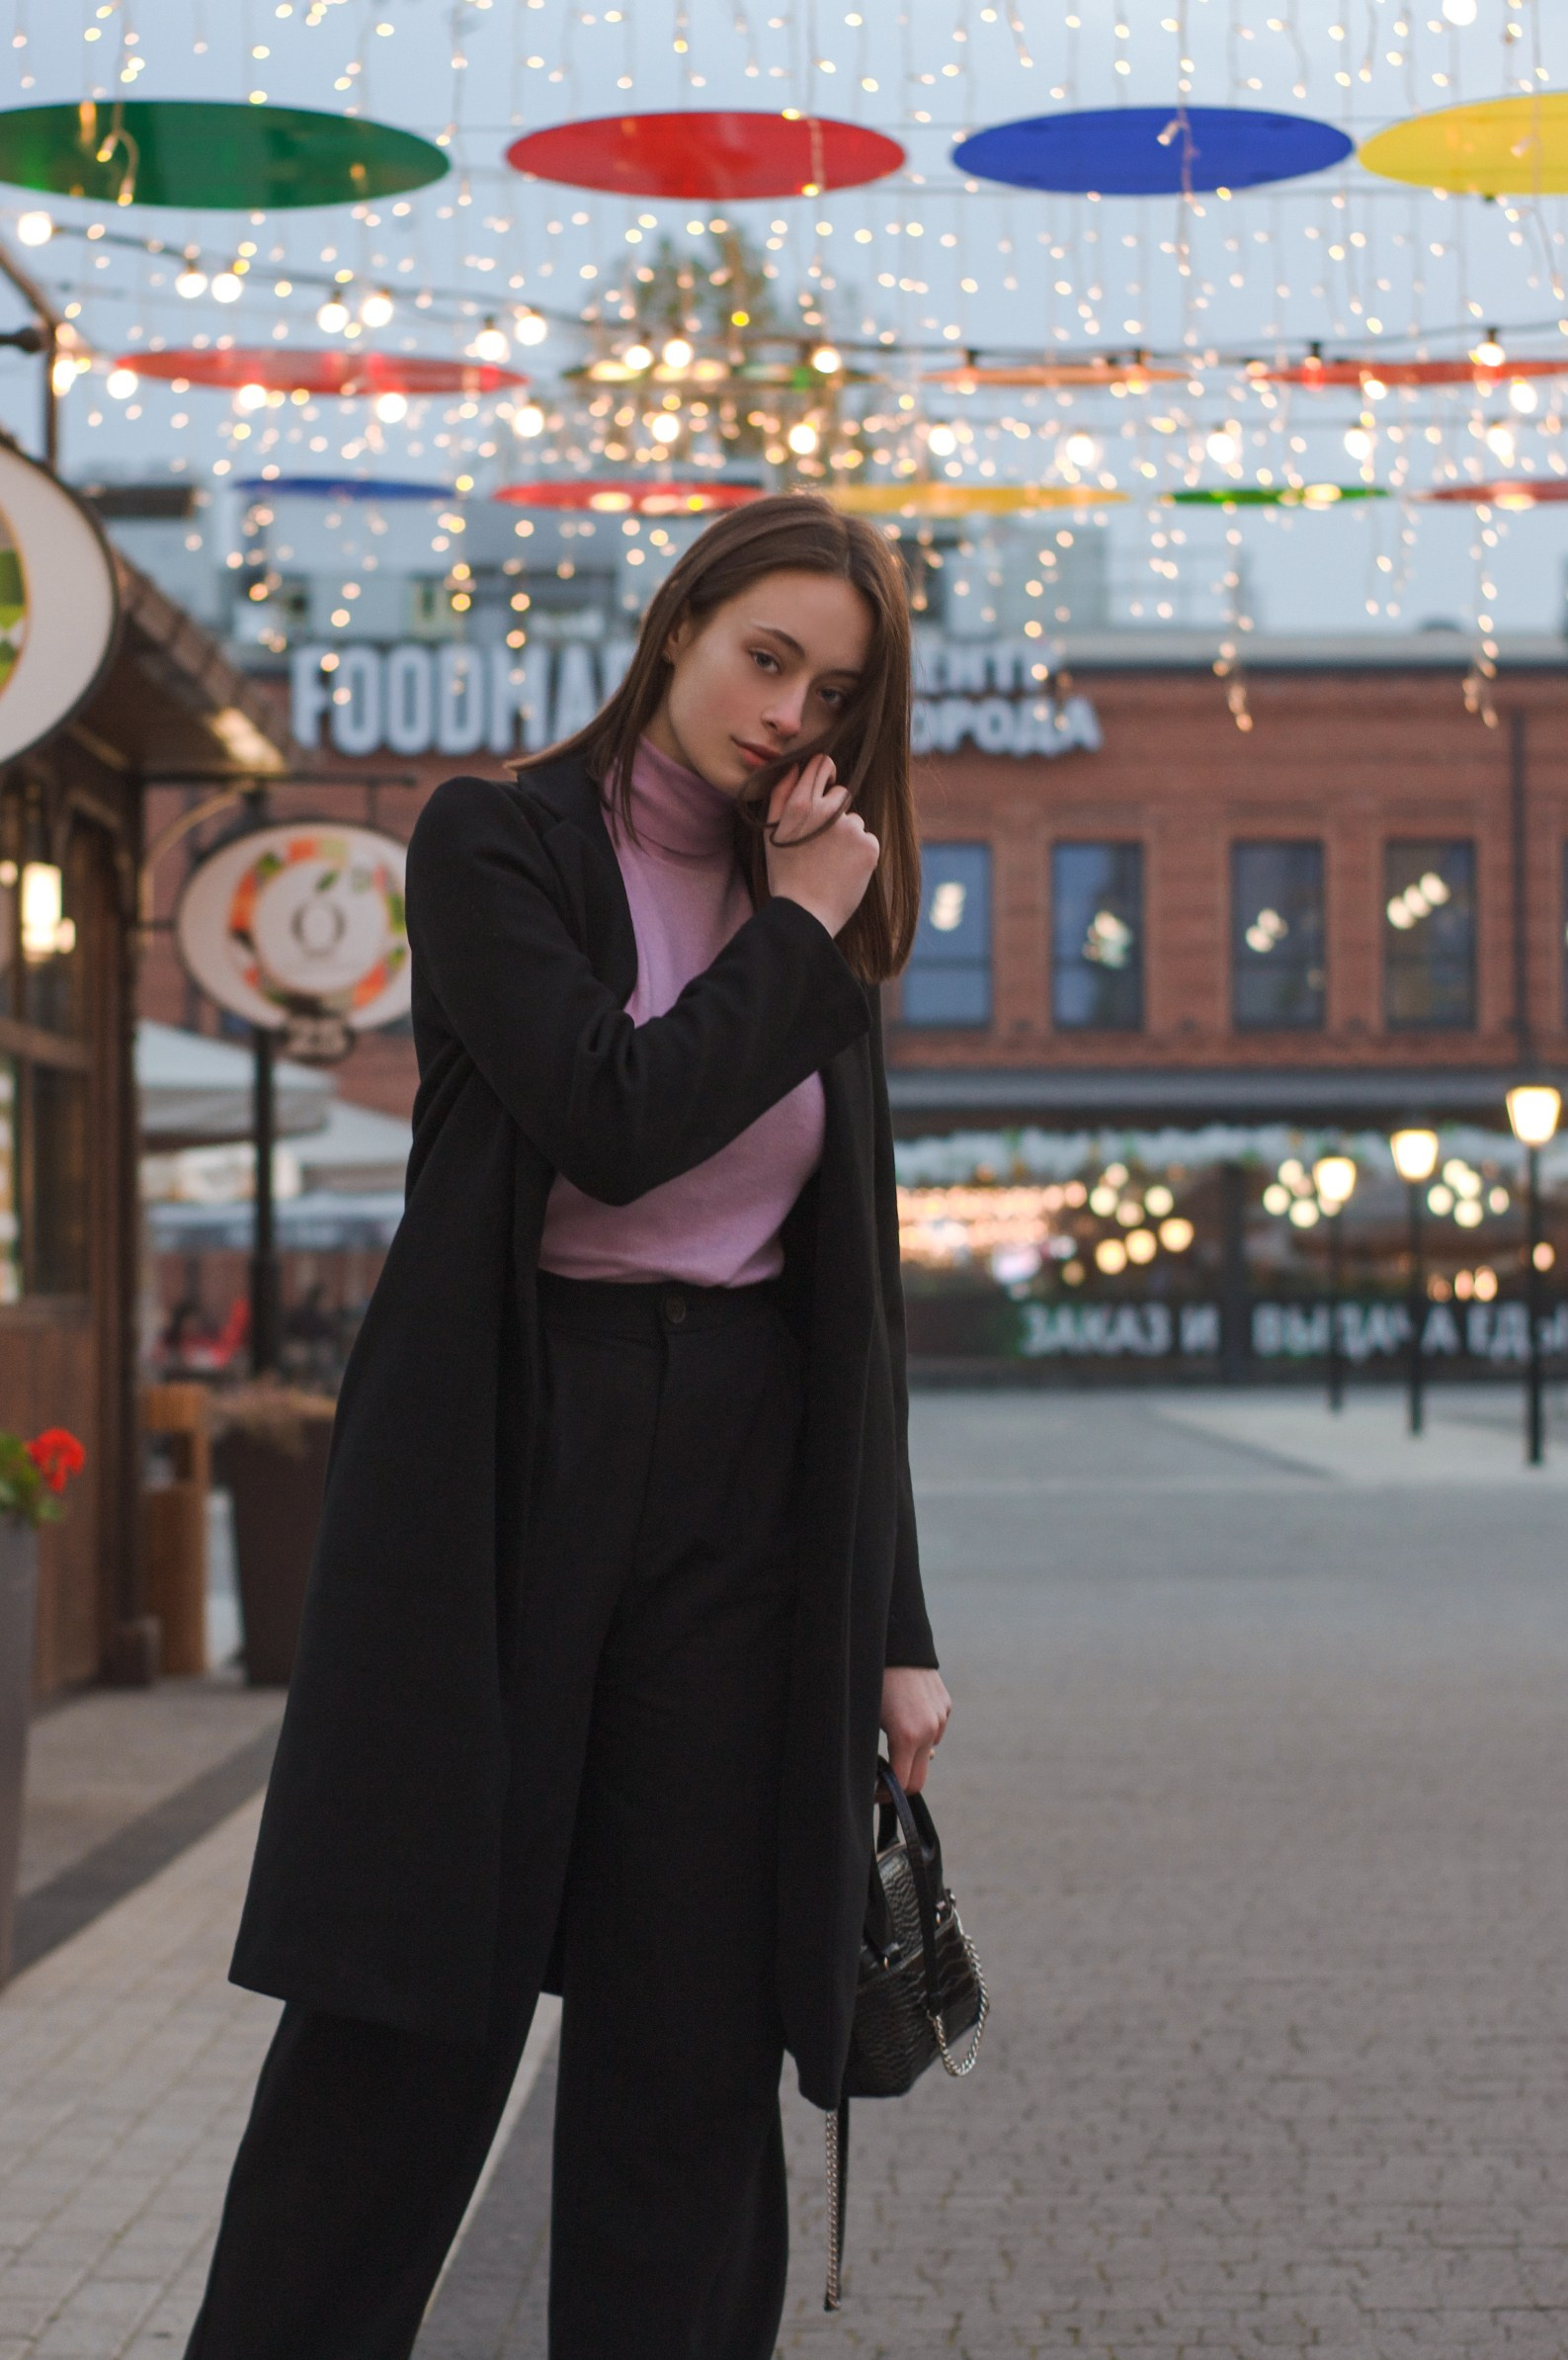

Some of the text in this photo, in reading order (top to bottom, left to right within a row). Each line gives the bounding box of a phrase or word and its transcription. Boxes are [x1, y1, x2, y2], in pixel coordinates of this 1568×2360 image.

[911, 640, 1061, 691] ЕНТР
[291, 643, 640, 759] FOODMA
[911, 695, 1103, 758] ОРОДА
[1023, 1304, 1173, 1356] ЗАКАЗ
